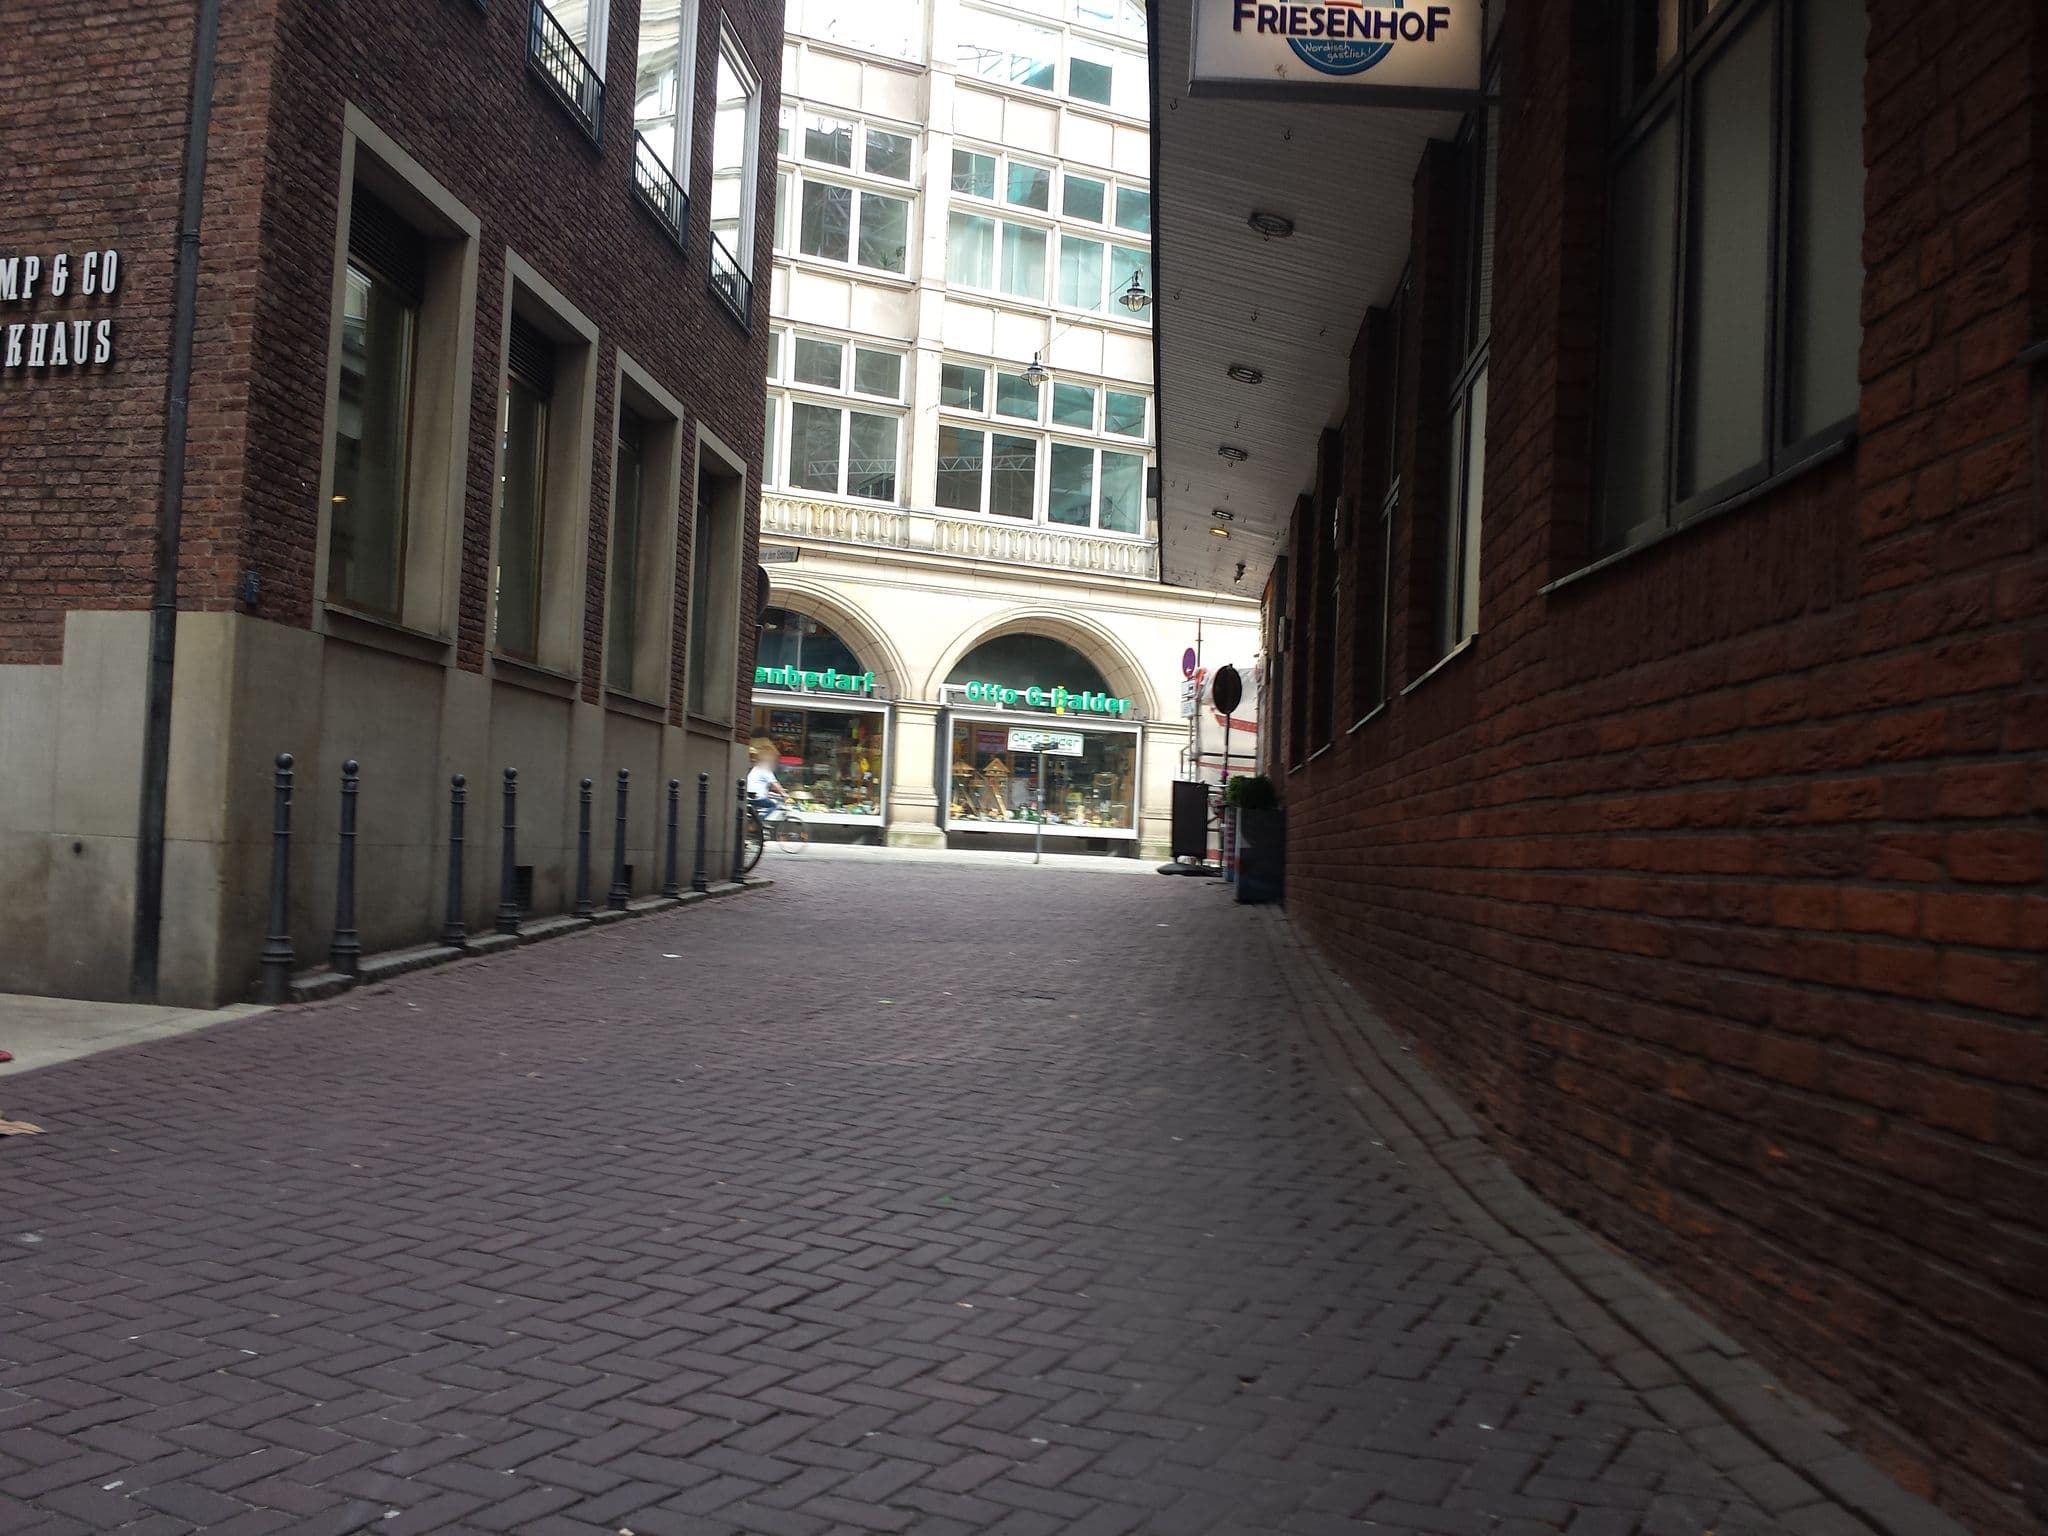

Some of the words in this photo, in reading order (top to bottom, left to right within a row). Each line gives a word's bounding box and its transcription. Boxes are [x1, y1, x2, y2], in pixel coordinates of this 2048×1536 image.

[1233, 0, 1450, 42] FRIESENHOF
[1305, 40, 1350, 53] Nordisch
[51, 253, 69, 297] &
[82, 250, 118, 296] CO
[0, 319, 111, 367] KHAUS
[965, 680, 1017, 705] Otto
